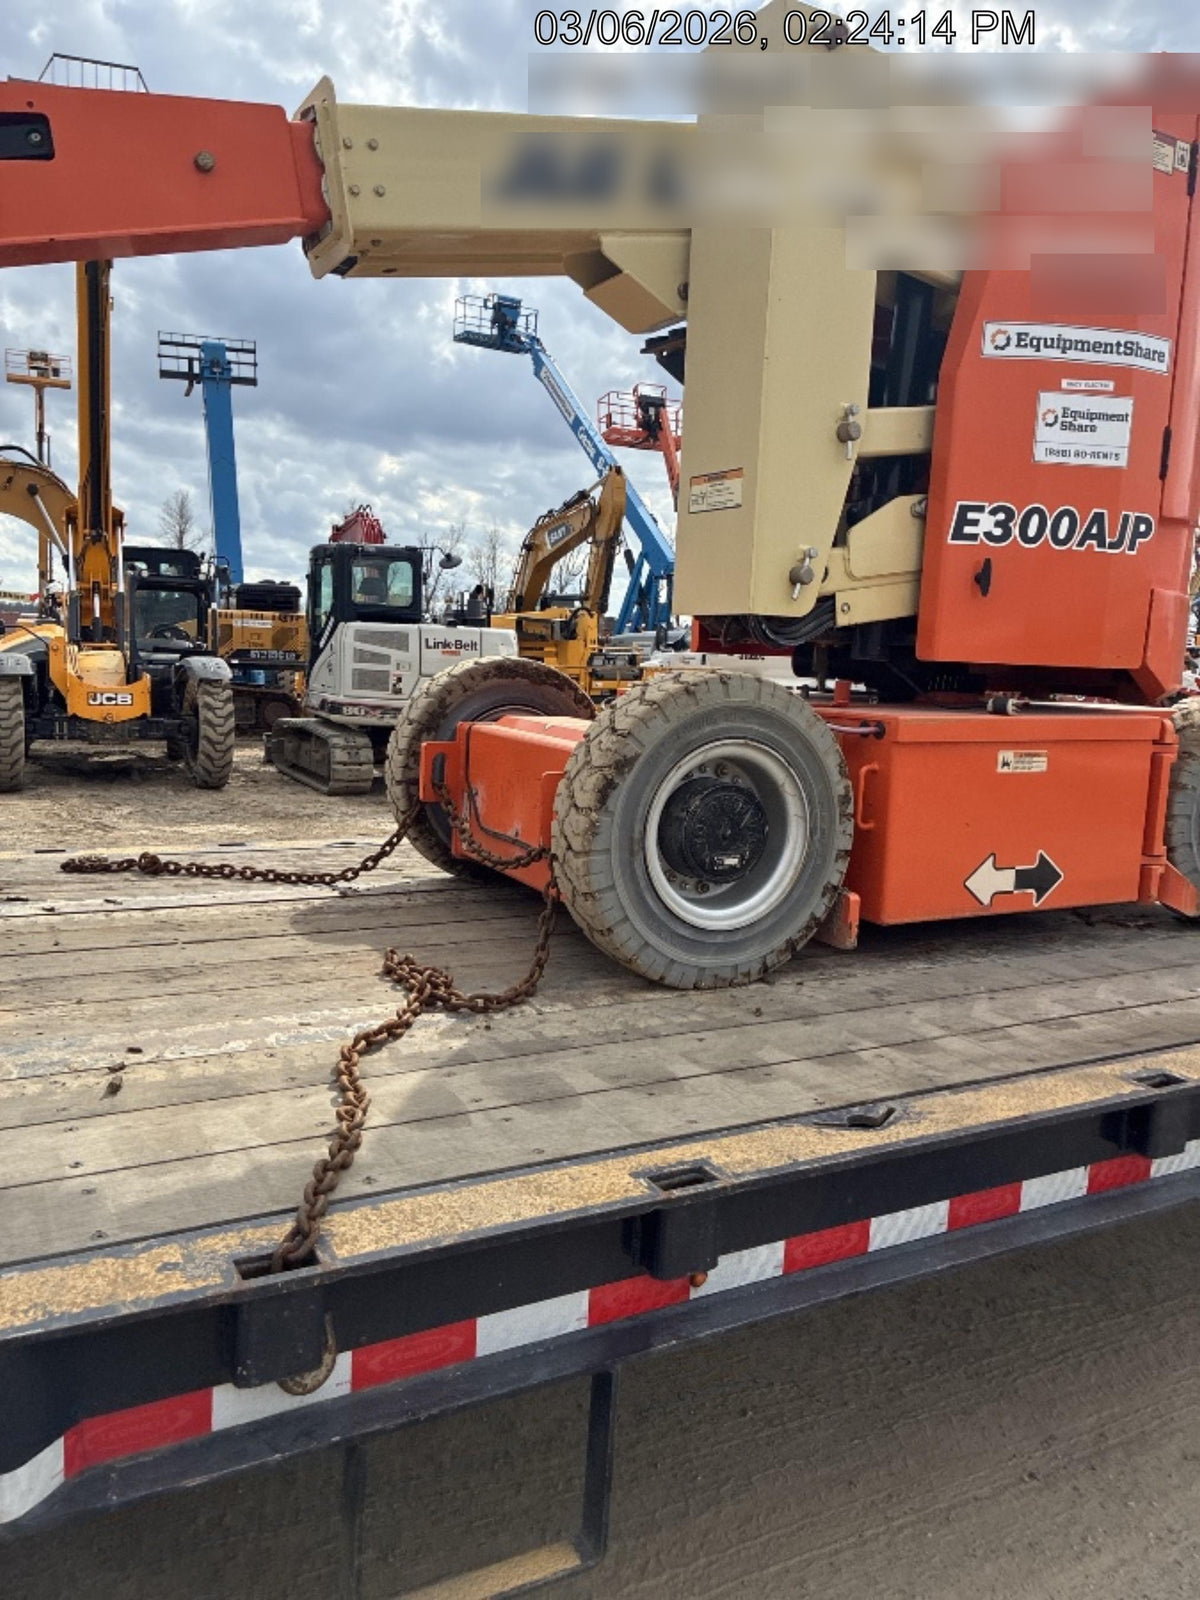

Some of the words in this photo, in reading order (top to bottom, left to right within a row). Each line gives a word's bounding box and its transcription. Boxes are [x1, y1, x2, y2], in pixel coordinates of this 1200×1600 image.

[1014, 331, 1167, 363] EquipmentShare
[1060, 406, 1130, 424] Equipment
[1059, 420, 1098, 433] Share
[948, 500, 1155, 555] E300AJP
[88, 692, 132, 705] JCB
